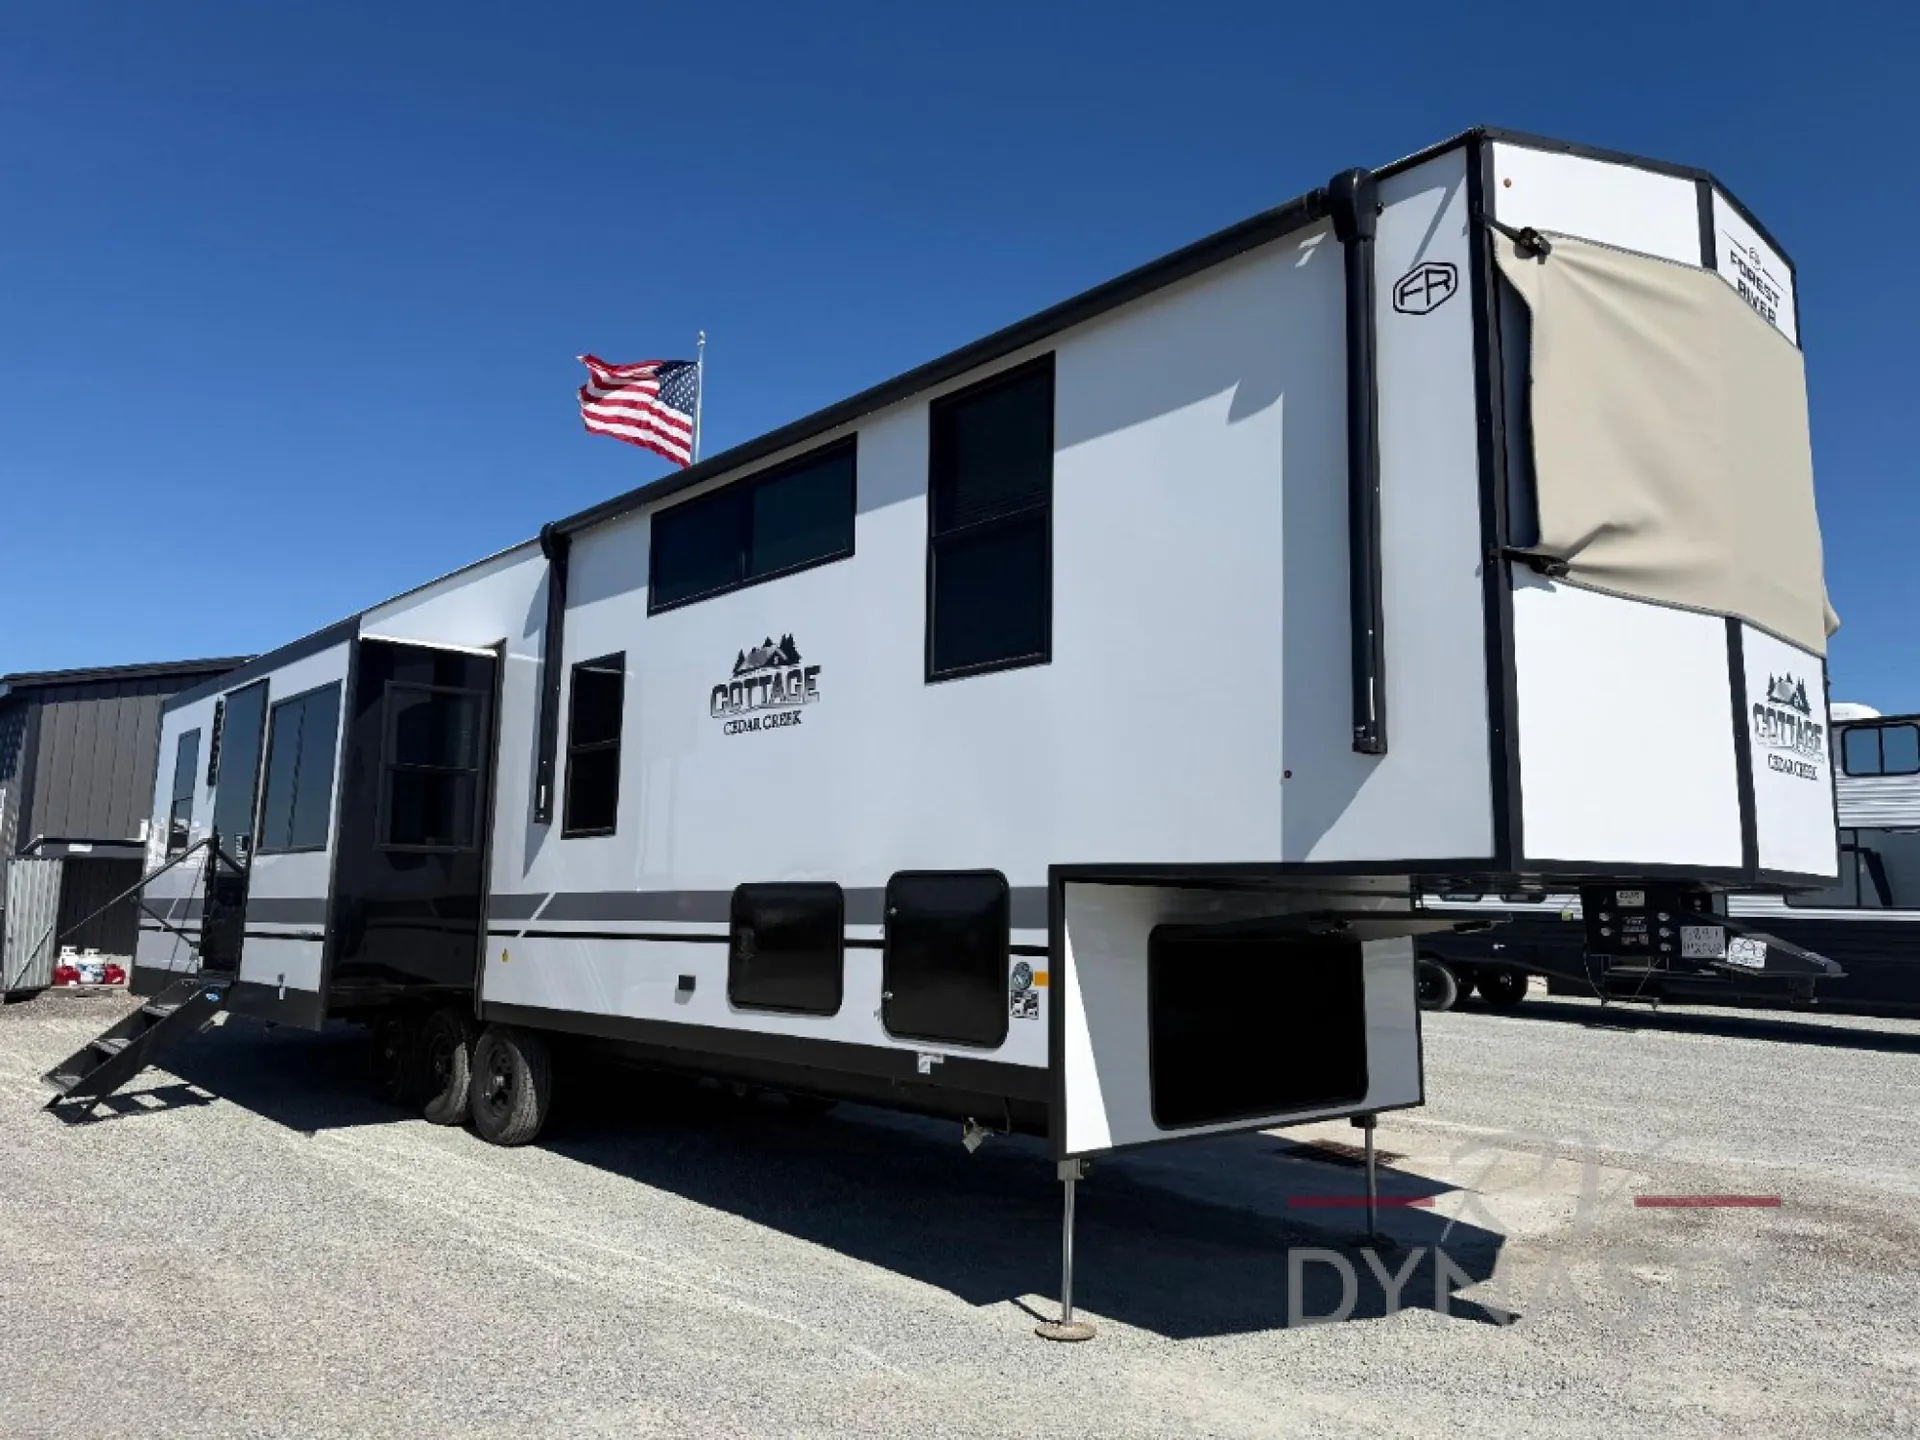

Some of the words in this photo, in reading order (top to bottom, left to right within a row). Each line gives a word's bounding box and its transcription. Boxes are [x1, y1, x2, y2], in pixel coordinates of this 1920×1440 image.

[1399, 269, 1452, 306] FR
[1730, 248, 1780, 308] FOREST
[710, 664, 821, 718] COTTAGE
[723, 717, 762, 735] CEDAR
[763, 710, 802, 730] CREEK
[1753, 702, 1823, 764] COTTAGE
